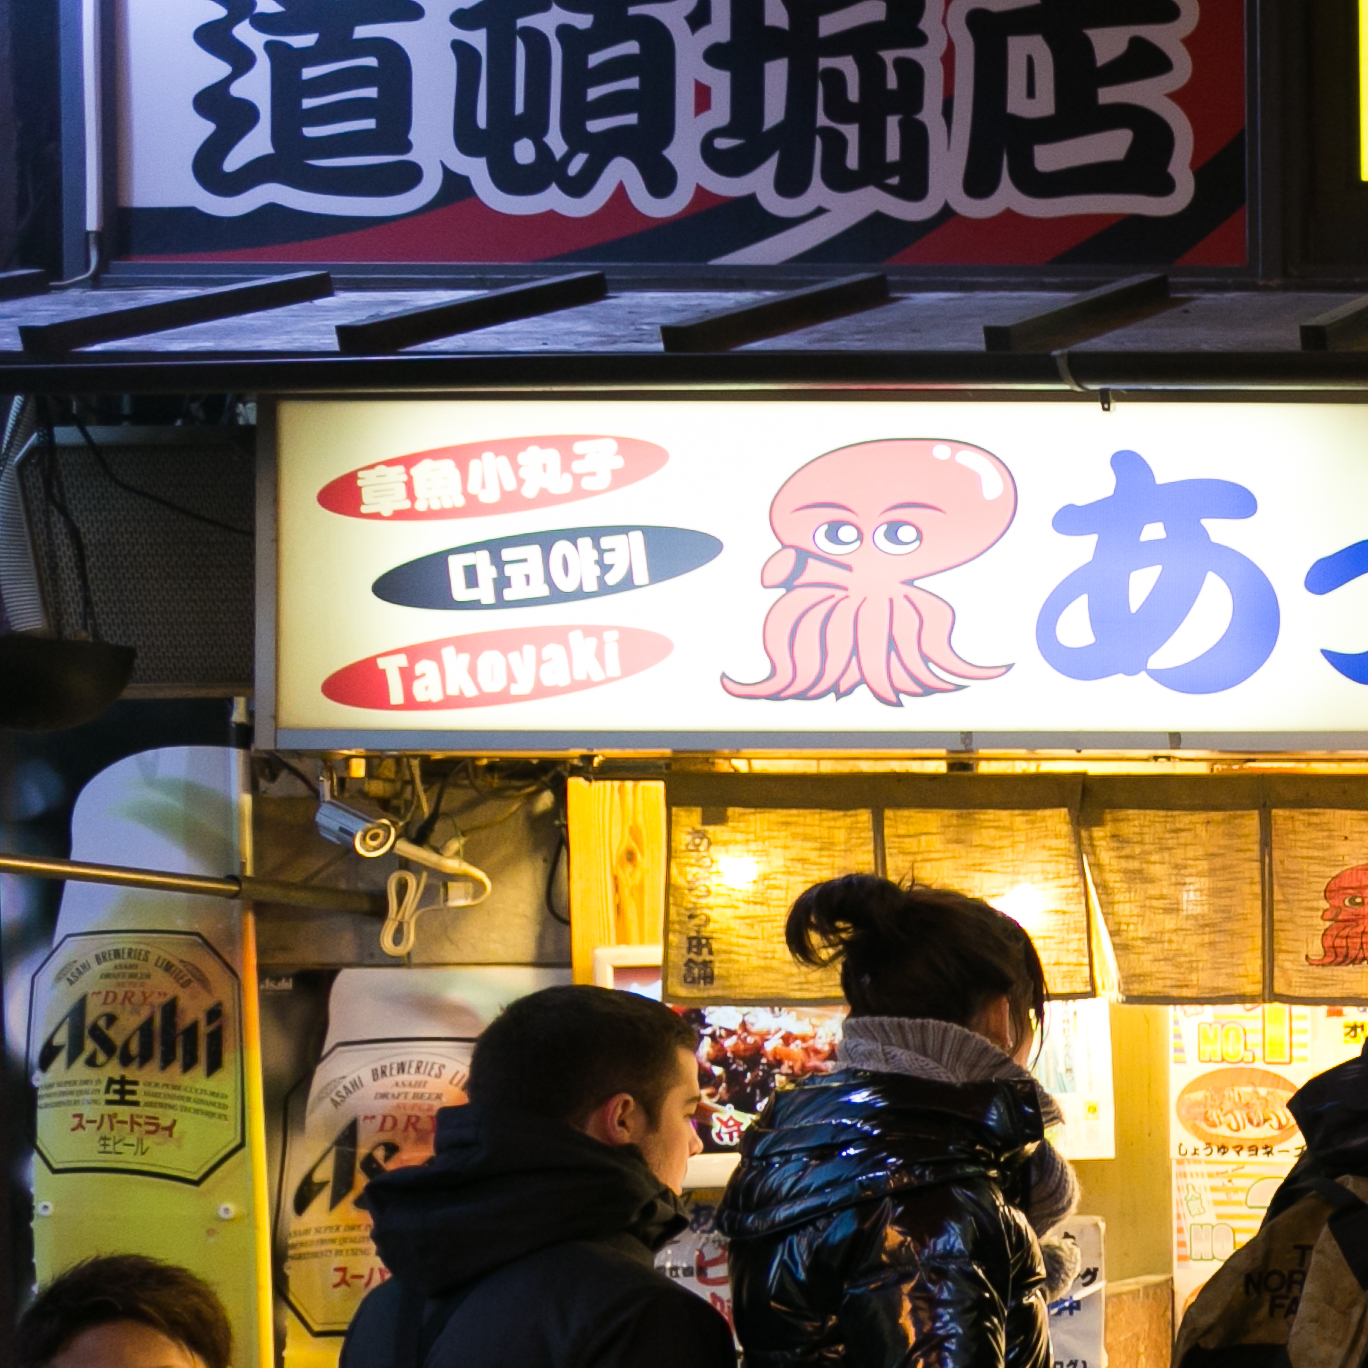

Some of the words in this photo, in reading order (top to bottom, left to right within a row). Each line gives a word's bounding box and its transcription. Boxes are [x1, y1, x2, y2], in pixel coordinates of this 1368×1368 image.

[193, 0, 1176, 200] 道頓堀店
[356, 437, 624, 517] 章魚小丸子
[449, 542, 649, 606] 다코야키
[377, 630, 622, 707] Takoyaki
[66, 960, 91, 986] ASAHI
[95, 947, 151, 965] BREWERIES
[154, 955, 193, 989] LIMITED
[38, 993, 223, 1078] Asahi
[1199, 1022, 1255, 1063] NO.
[104, 1074, 140, 1107] 生
[330, 1075, 364, 1109] ASAHI
[371, 1059, 446, 1082] BREWERIES
[70, 1112, 177, 1139] スーパードライ
[97, 1135, 150, 1157] 生ビール
